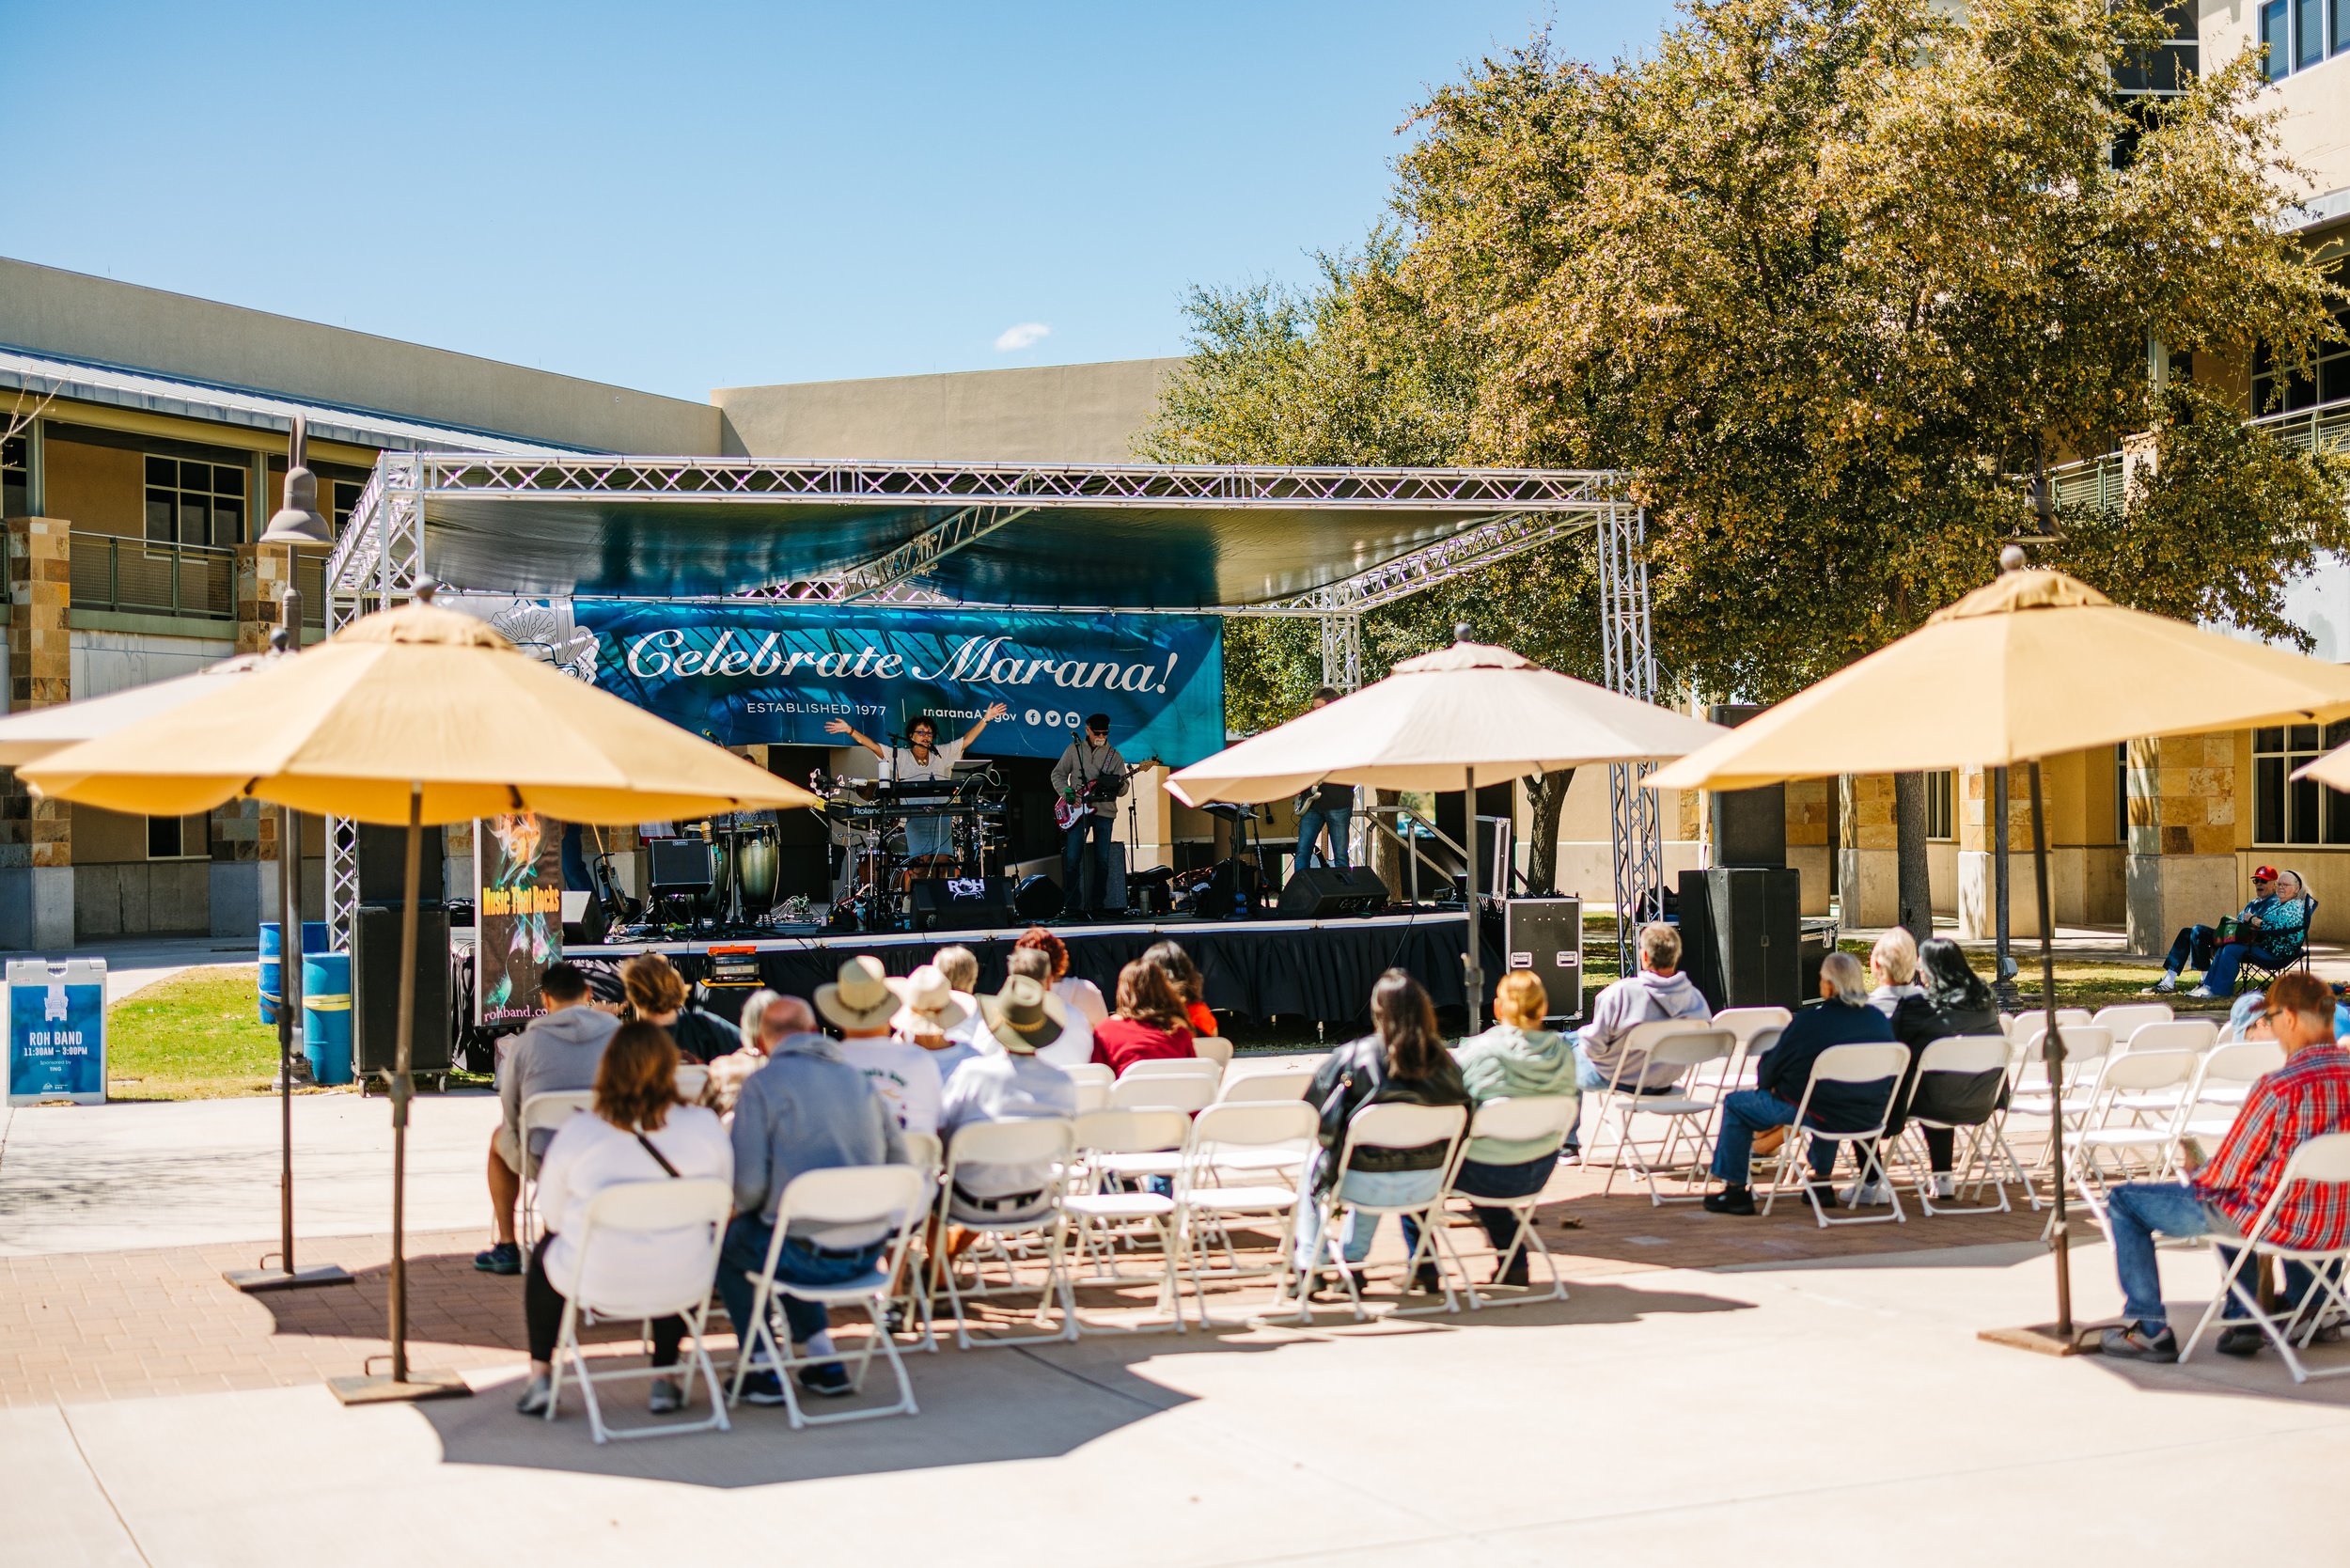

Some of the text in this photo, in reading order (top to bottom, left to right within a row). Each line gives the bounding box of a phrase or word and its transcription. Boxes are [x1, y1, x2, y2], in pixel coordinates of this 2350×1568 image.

[627, 629, 1179, 694] Celebrate Marana!
[747, 702, 886, 715] ESTABLISHED 1977
[922, 708, 1017, 723] maranaA.gov
[482, 885, 560, 916] Music That Rocks
[484, 1004, 549, 1022] rohband.co
[29, 1030, 83, 1046] ROH BAND
[24, 1047, 55, 1057] 11:30AM
[62, 1046, 87, 1056] 3:00PM
